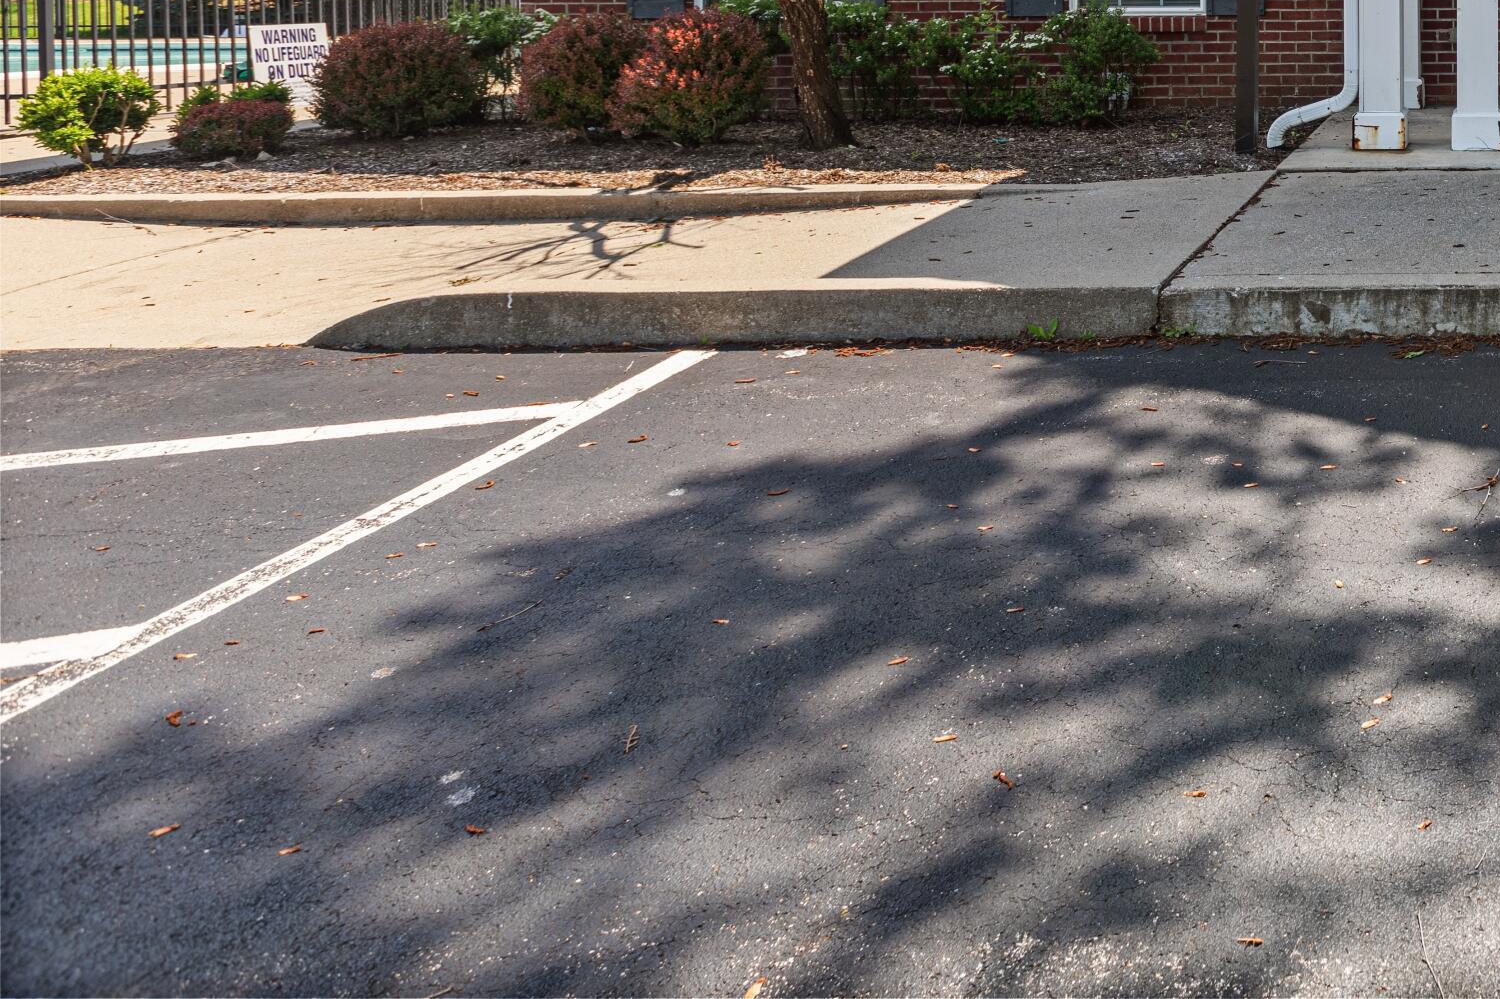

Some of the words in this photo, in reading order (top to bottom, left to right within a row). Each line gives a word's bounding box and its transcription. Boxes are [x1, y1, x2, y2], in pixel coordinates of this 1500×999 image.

[261, 28, 316, 44] WARNING
[255, 48, 269, 63] NO
[272, 45, 325, 61] LIFEGUARD
[268, 65, 284, 80] ON
